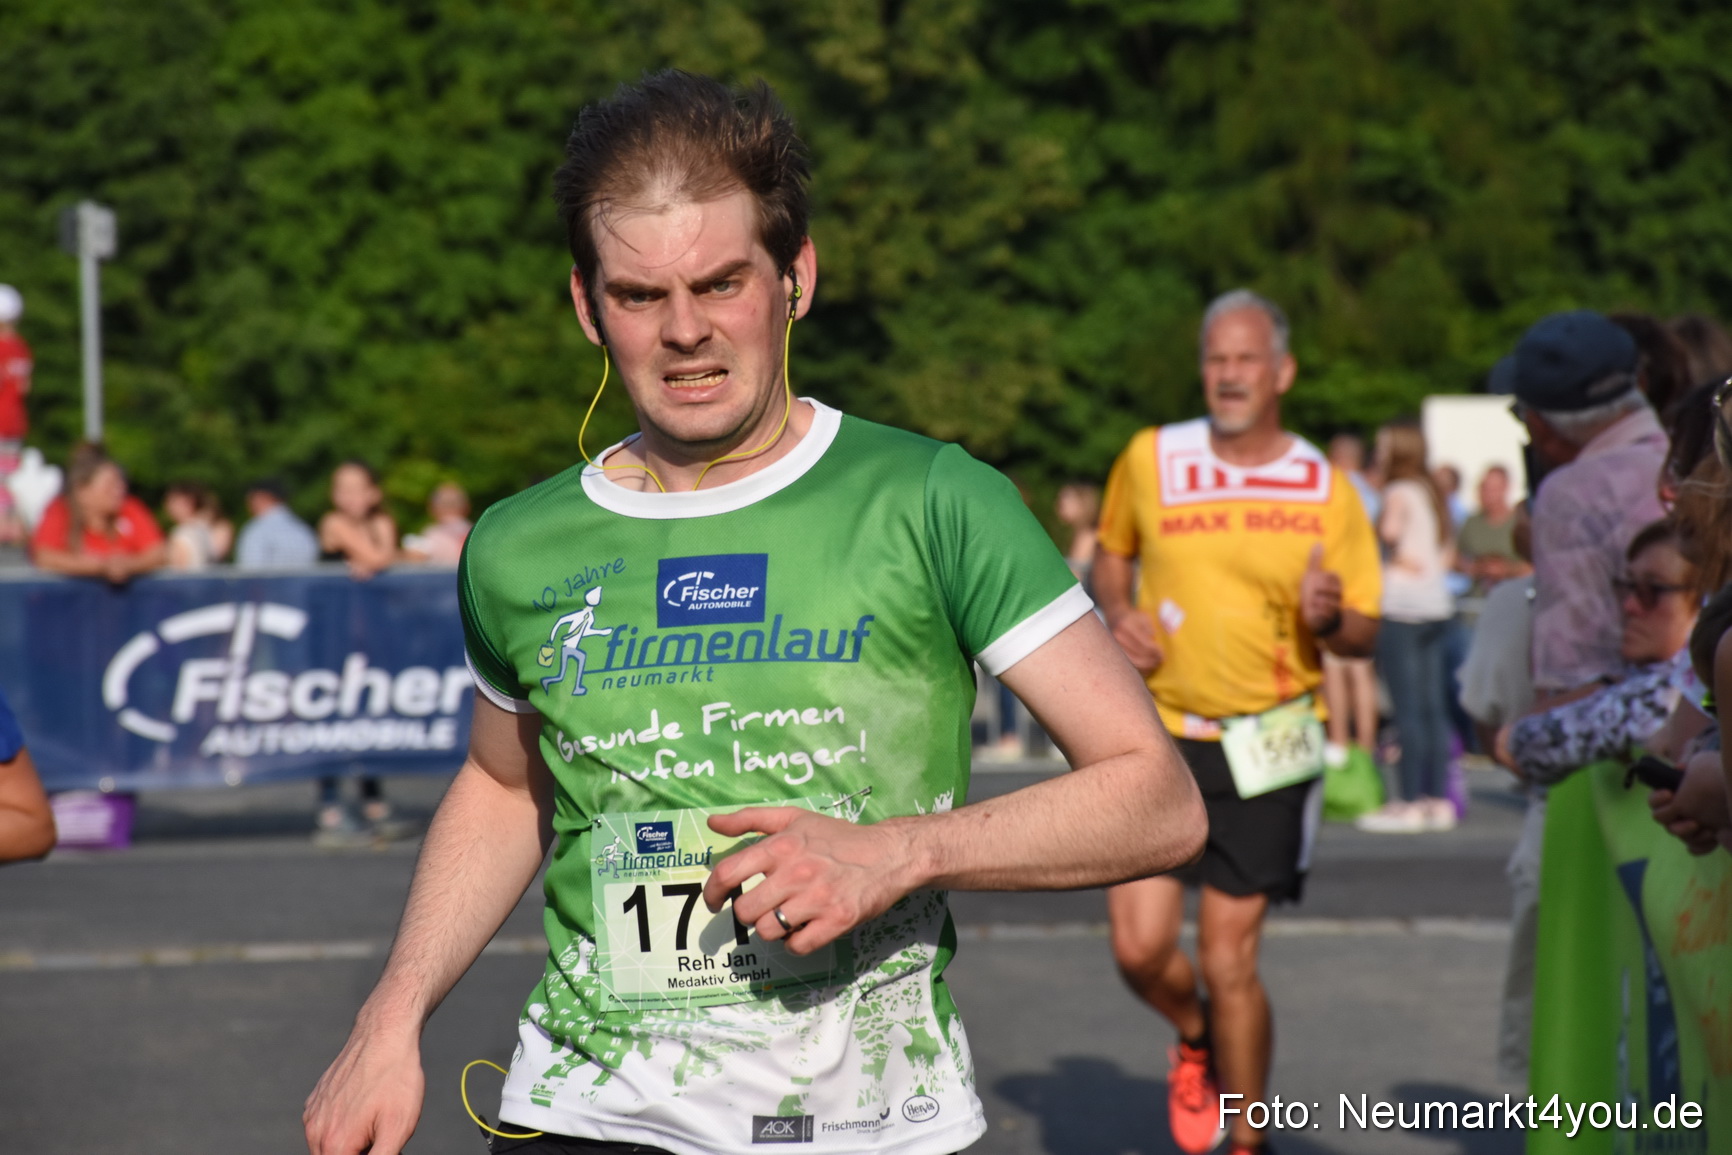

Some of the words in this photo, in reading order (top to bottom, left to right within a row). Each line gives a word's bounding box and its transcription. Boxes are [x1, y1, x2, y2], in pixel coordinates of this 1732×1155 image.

[1161, 512, 1228, 536] MAX
[1244, 507, 1325, 536] BÖGL
[532, 586, 556, 613] 10
[564, 557, 627, 598] Jahre
[680, 583, 759, 603] Fischer
[687, 600, 752, 611] AUTOMOBILE
[599, 614, 875, 672] firmenlauf
[172, 651, 477, 724] Fischer
[601, 666, 714, 690] neumarkt
[201, 717, 458, 758] AUTOMOBILE
[557, 708, 684, 763] Gesunde
[701, 702, 845, 735] Firmen
[733, 729, 866, 785] länger!
[622, 846, 713, 870] firmenlauf
[624, 869, 661, 878] neumarkt
[677, 956, 715, 972] Reh
[722, 952, 757, 968] Jan
[667, 975, 725, 989] Medaktiv
[729, 967, 771, 983] GmbH
[760, 1120, 795, 1135] AOK
[822, 1119, 881, 1132] Frischmann
